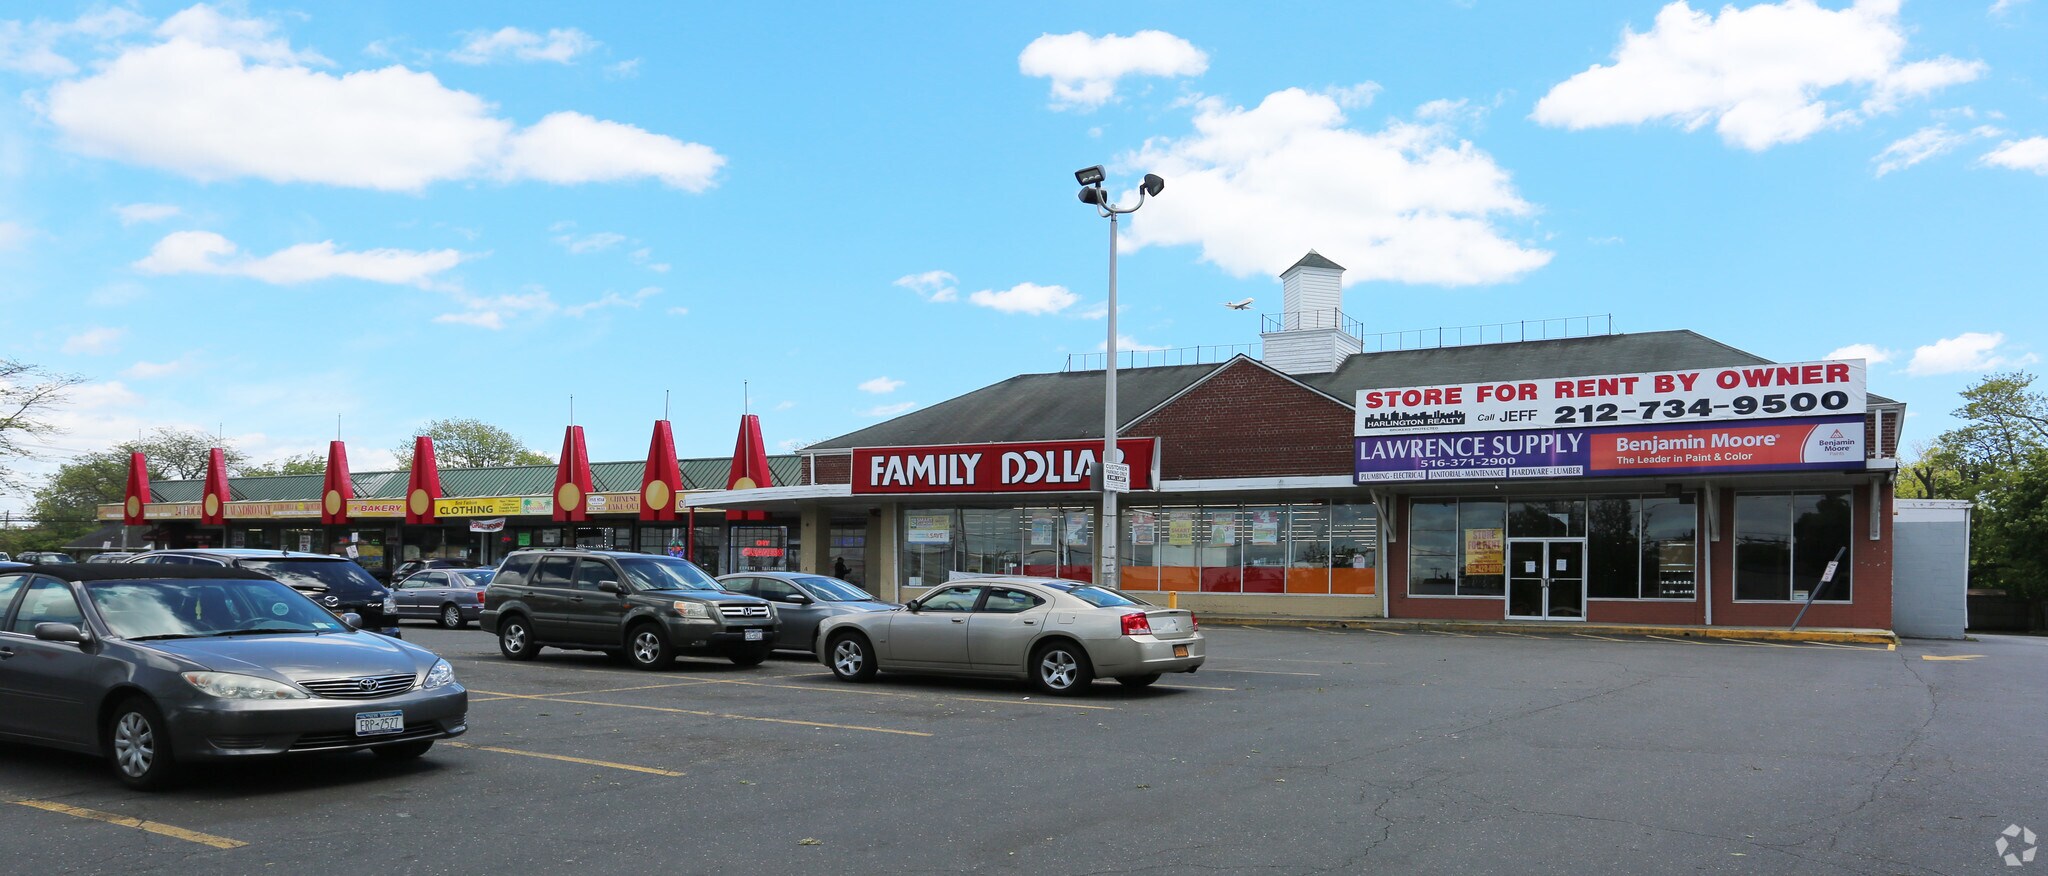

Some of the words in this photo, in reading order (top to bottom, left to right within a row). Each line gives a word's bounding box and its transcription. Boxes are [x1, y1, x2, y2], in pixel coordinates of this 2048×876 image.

[1366, 387, 1462, 409] STORE
[1476, 382, 1538, 403] FOR
[1554, 376, 1639, 399] RENT
[1654, 372, 1700, 393] BY
[1716, 363, 1850, 390] OWNER
[1554, 390, 1849, 424] 212-734-9500
[1367, 418, 1424, 428] HARLINGTON
[1427, 416, 1463, 425] REALTY
[1477, 412, 1496, 423] Call
[1499, 409, 1538, 423] JEFF
[1360, 436, 1485, 461] LAWRENCE
[1492, 432, 1584, 455] SUPPLY
[1617, 434, 1706, 455] Benjamin
[1819, 438, 1855, 447] Benjamin
[1420, 456, 1516, 468] 516-371-2900
[1617, 456, 1635, 465] The
[1637, 454, 1670, 464] Leader
[1673, 454, 1683, 463] in
[1685, 453, 1712, 462] Paint
[1714, 453, 1722, 461] &
[1724, 451, 1753, 461] Color
[870, 453, 982, 486] FAMILY
[1511, 467, 1548, 476] HARDWARE
[1553, 466, 1581, 475] LUMBER
[224, 502, 272, 516] LAUNDROMAT
[440, 505, 494, 515] CLOTHING
[608, 503, 639, 511] TAKE-OUT
[1472, 530, 1496, 540] STORE
